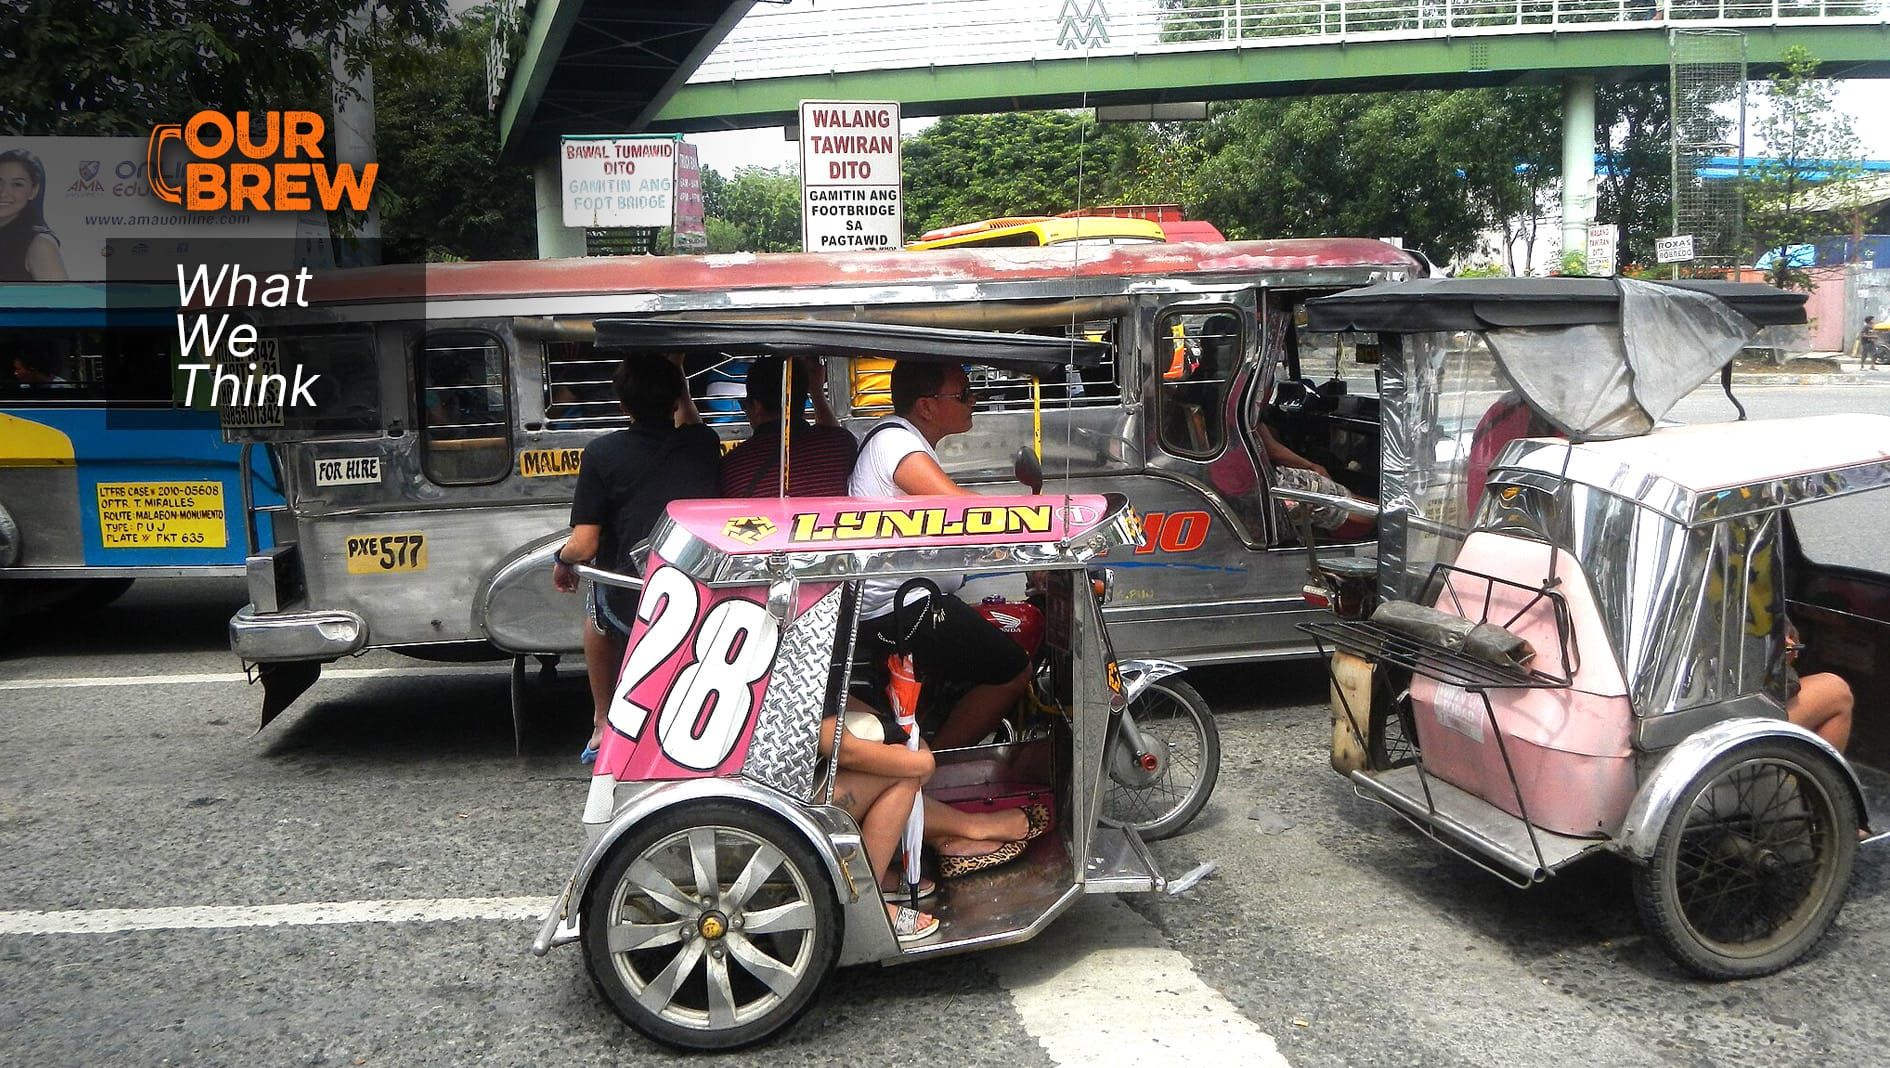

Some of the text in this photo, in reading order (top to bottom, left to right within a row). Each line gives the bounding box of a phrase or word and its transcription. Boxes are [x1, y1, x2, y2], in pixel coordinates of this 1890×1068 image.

[813, 110, 890, 128] WALANG
[566, 144, 673, 160] BAWAL TUMAWID
[811, 135, 893, 154] TAWIRAN
[603, 161, 636, 175] DITO
[829, 161, 871, 179] DITO
[569, 180, 631, 194] GAMITIN
[639, 178, 671, 192] ANG
[574, 196, 613, 210] FOOT
[617, 194, 666, 210] BRIDGE
[809, 189, 897, 201] GAMITIN ANG
[811, 204, 896, 216] FOOTBRIDGE
[846, 220, 863, 231] SA
[821, 235, 888, 246] PAGTAWID
[319, 459, 379, 481] FOR HIRE
[523, 450, 585, 474] MALAB
[144, 498, 195, 508] MIRALLES
[788, 505, 1052, 544] LYNLON
[107, 534, 138, 544] PLATE
[156, 533, 178, 543] PKT
[181, 532, 205, 543] 635
[347, 535, 424, 570] PXE 577
[607, 565, 779, 771] 28
